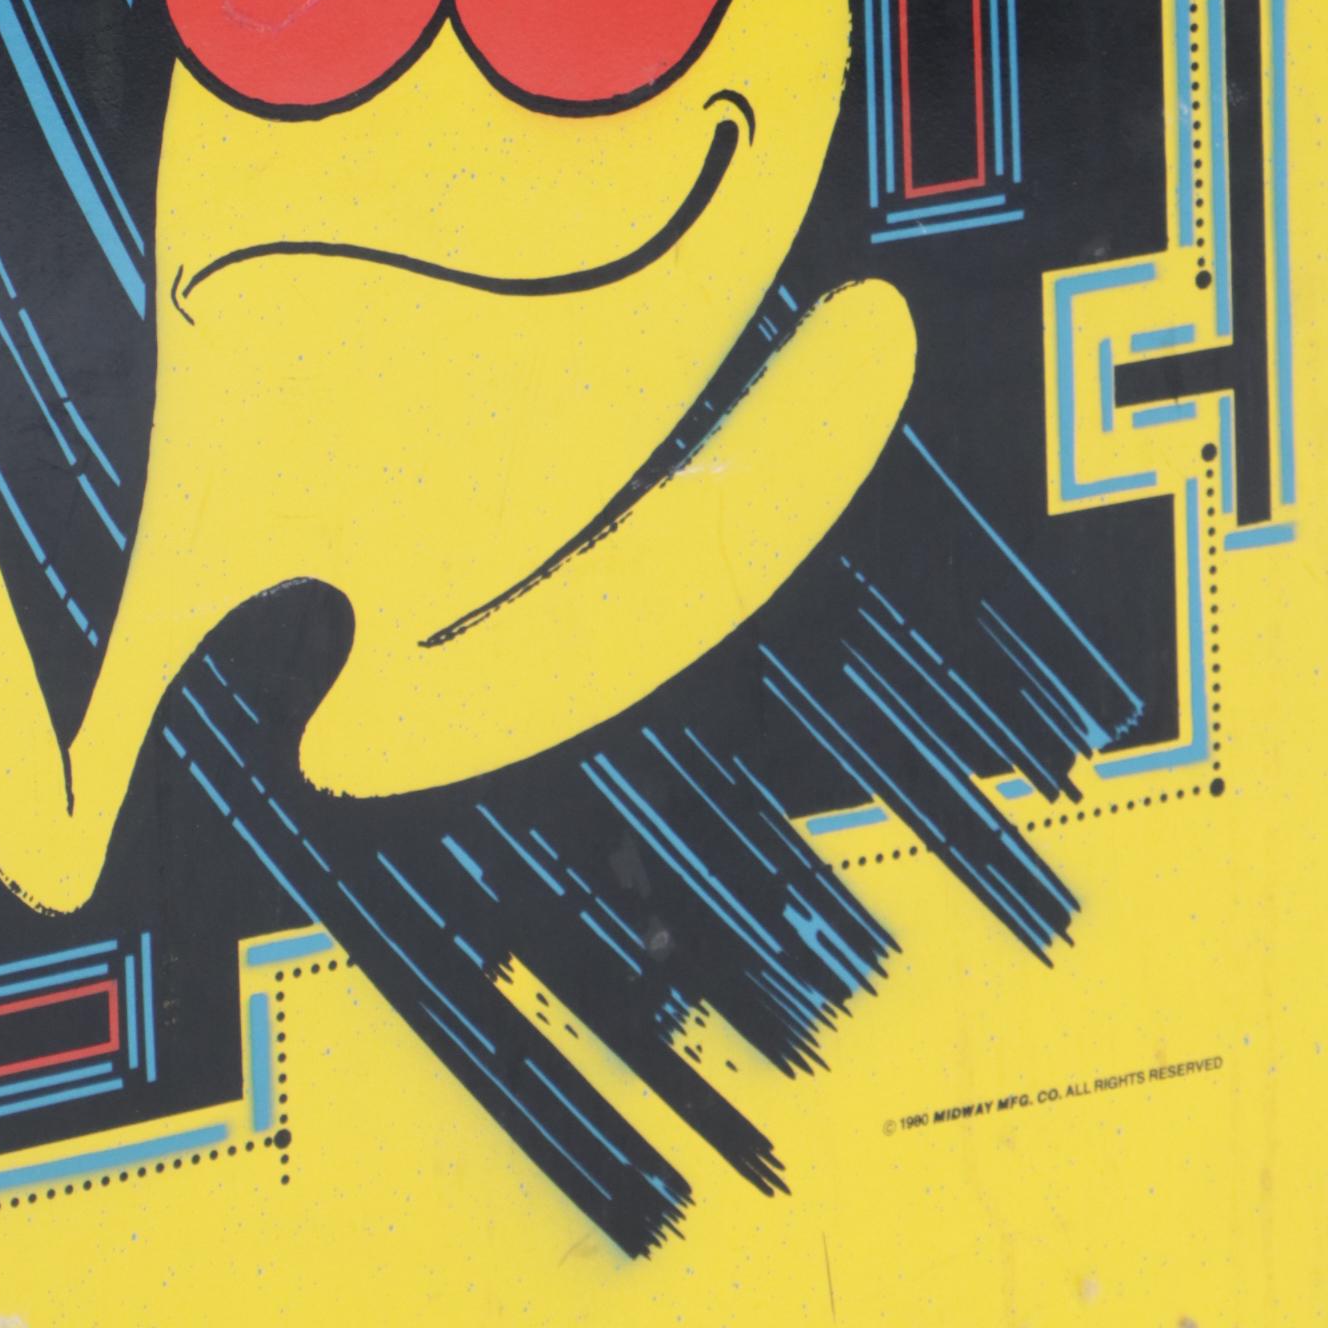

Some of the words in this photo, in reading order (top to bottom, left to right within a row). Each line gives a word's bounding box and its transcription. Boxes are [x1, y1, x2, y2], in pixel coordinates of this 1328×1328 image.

[900, 1113, 929, 1130] 1980
[933, 1100, 993, 1123] MIDWAY
[997, 1094, 1033, 1111] MFG.
[1037, 1088, 1062, 1103] CO.
[1065, 1083, 1091, 1098] ALL
[1094, 1072, 1145, 1092] RIGHTS
[1148, 1056, 1223, 1082] RESERVED
